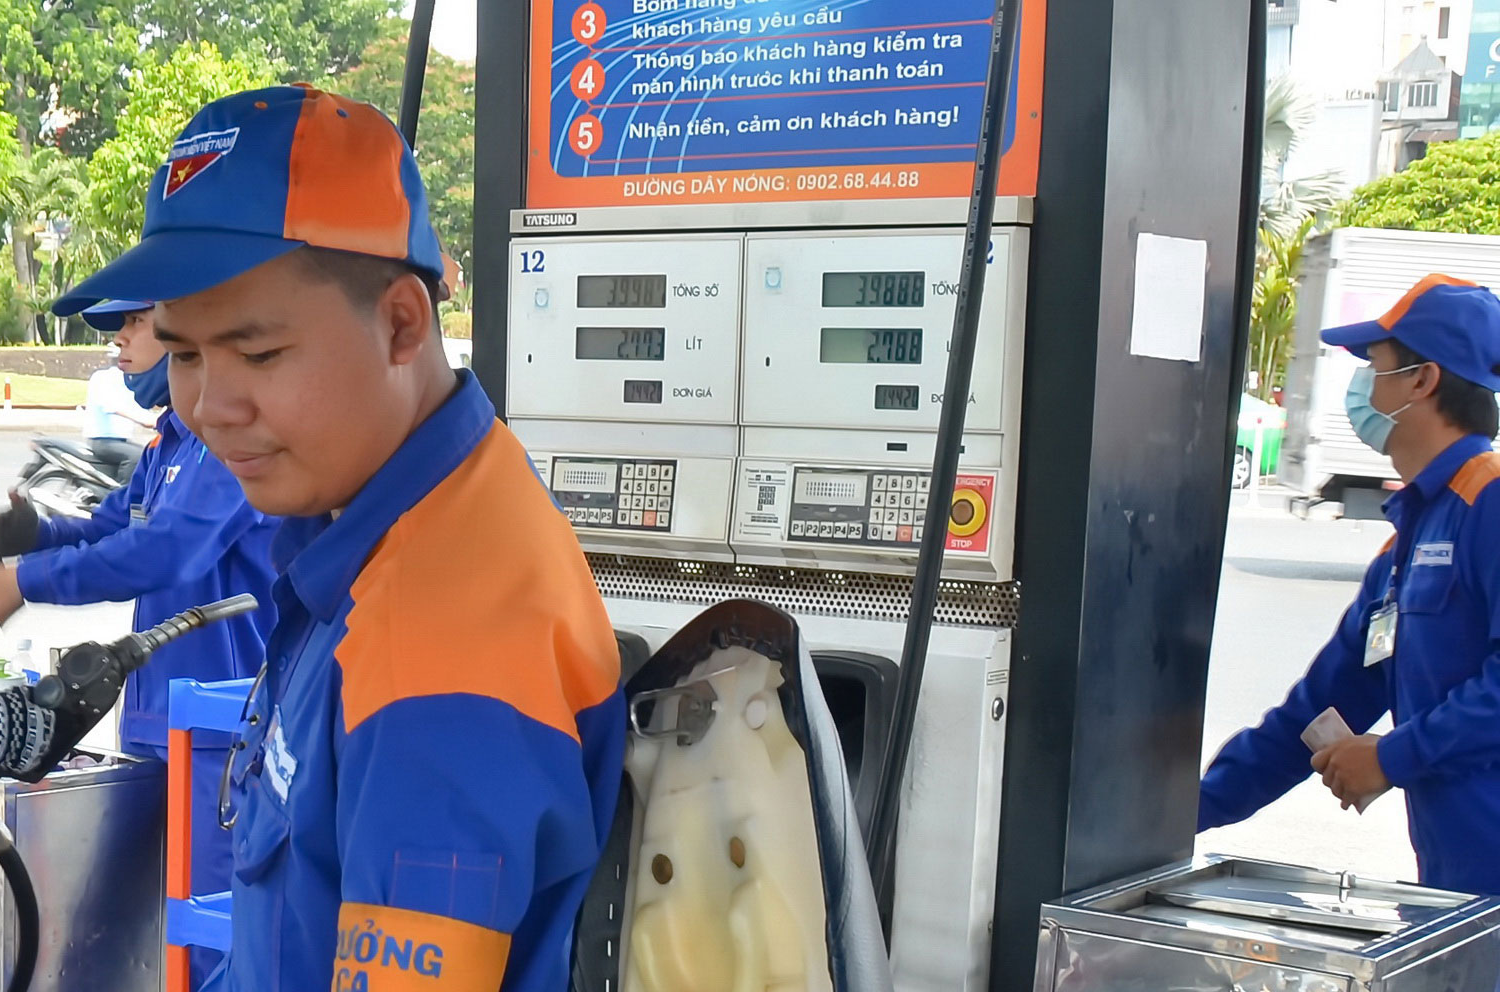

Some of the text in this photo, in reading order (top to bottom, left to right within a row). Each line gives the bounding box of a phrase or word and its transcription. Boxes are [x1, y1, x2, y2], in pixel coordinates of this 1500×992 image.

[580, 10, 596, 39] 3
[632, 6, 842, 39] khách hàng yêu cầu
[632, 31, 963, 70] Thông báo khách hàng kiểm tra
[578, 65, 596, 94] 4
[632, 59, 944, 96] màn hình trước khi thanh toán
[577, 121, 594, 150] 5
[629, 105, 960, 142] Nhận tiền, cảm ơn khách hàng!
[623, 171, 919, 197] ĐƯỜNG DÂY NÓNG: 0902.68.44.88
[525, 214, 575, 226] TATSUNO
[520, 250, 546, 273] 12
[685, 336, 703, 350] LÍT
[956, 477, 991, 487] ERGENCY
[792, 523, 861, 536] P1 P2 P3 P4 P5
[951, 539, 973, 549] STOP
[337, 918, 444, 979] ƯỞNG
